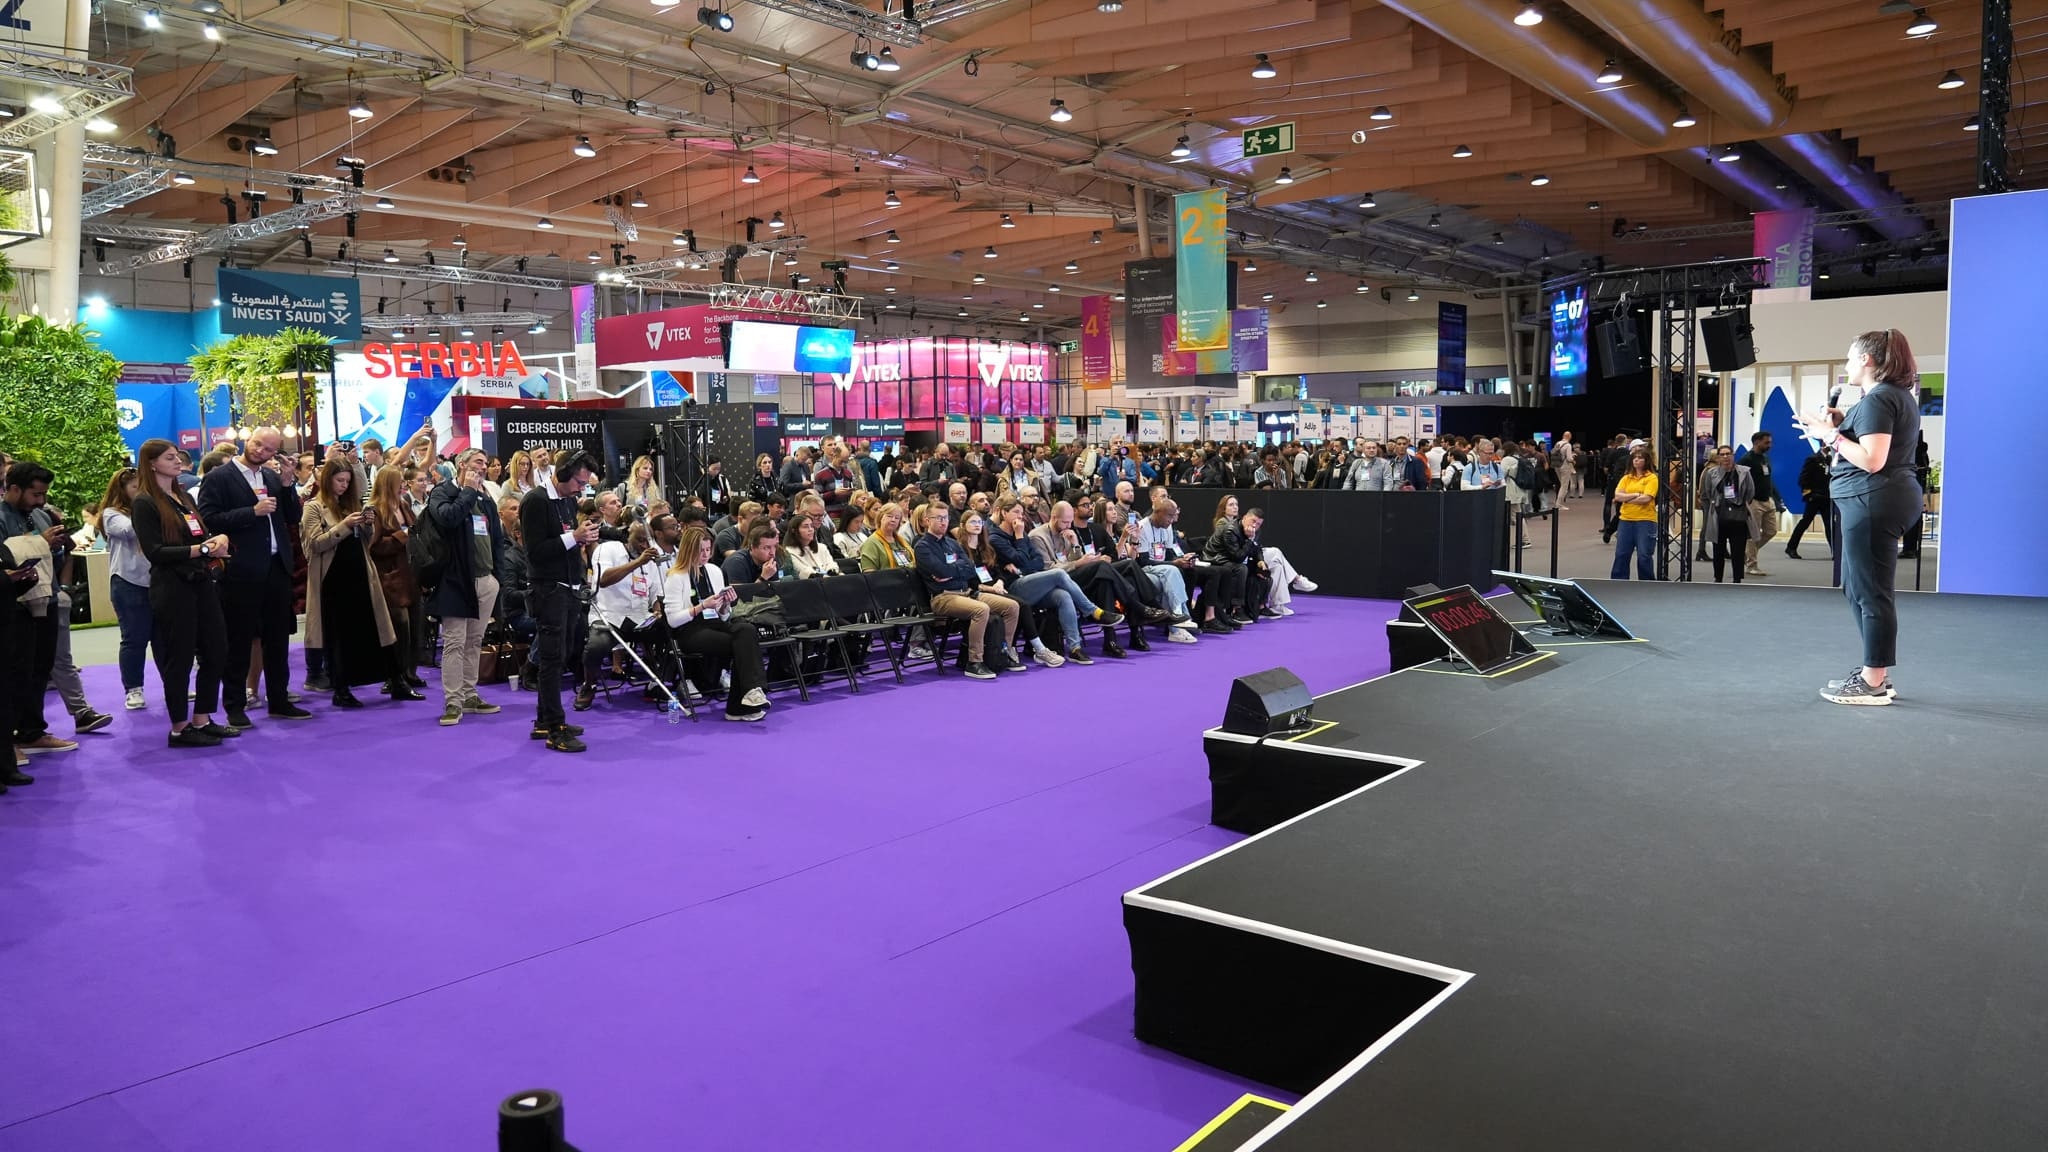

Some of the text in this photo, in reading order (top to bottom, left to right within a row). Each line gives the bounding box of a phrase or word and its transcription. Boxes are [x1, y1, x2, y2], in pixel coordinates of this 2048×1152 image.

[1181, 206, 1204, 246] 2
[231, 292, 326, 310] استثمر في السعودية
[232, 307, 326, 324] INVEST SAUDI
[1568, 299, 1584, 320] 07
[703, 314, 739, 324] The Backbone
[1085, 314, 1099, 337] 4
[666, 326, 691, 342] VTEX
[703, 326, 712, 334] for
[703, 336, 721, 345] Comm
[363, 341, 527, 379] SERBIA
[861, 363, 901, 383] VTEX
[1009, 363, 1043, 382] VTEX
[480, 380, 513, 389] SERBIA
[715, 392, 721, 403] 2
[507, 422, 597, 434] CIBERSECURITY
[1303, 422, 1317, 431] AdUp
[523, 439, 583, 450] SPAIN HUB
[1431, 601, 1492, 632] 00:00:46
